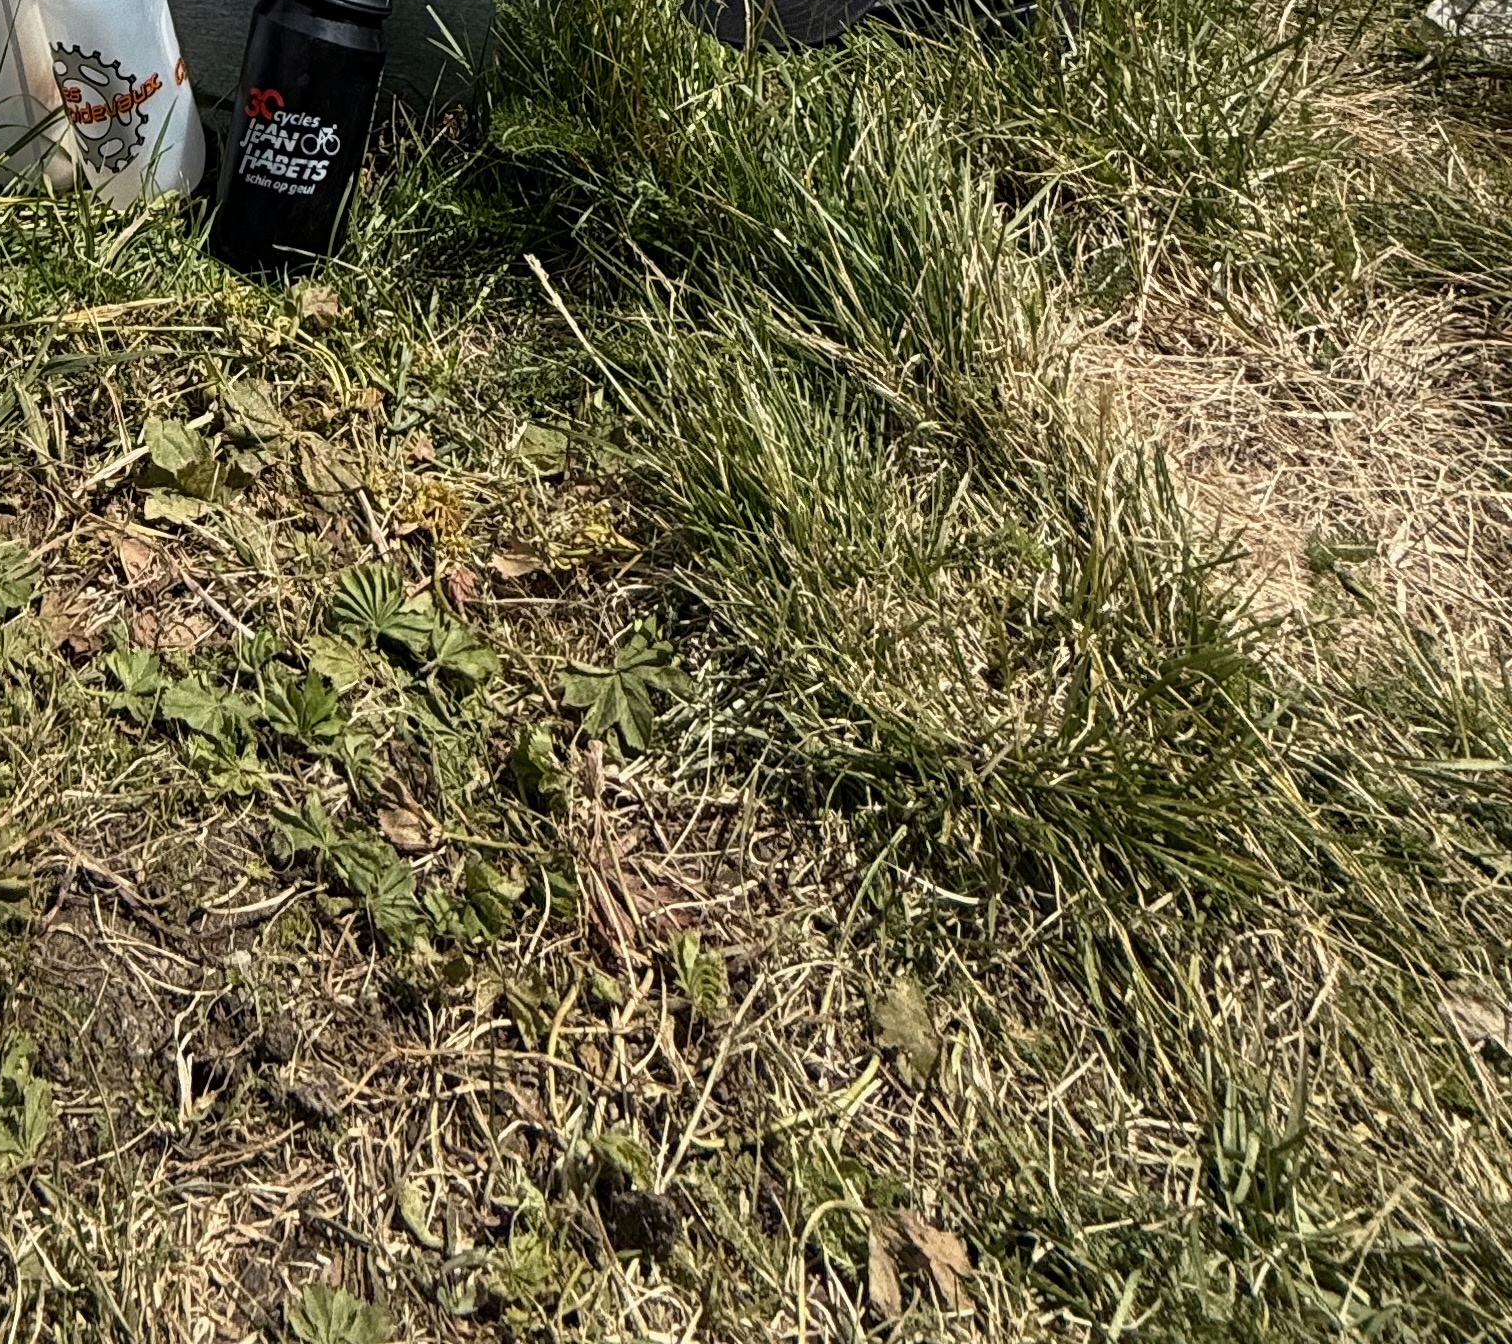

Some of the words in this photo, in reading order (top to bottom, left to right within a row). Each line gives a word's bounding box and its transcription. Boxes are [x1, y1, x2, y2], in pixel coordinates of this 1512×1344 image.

[274, 110, 321, 128] cycles
[240, 118, 300, 151] JEAN
[239, 143, 330, 182] HABETS
[245, 173, 272, 188] schin
[273, 181, 288, 194] op
[288, 184, 316, 195] geul
